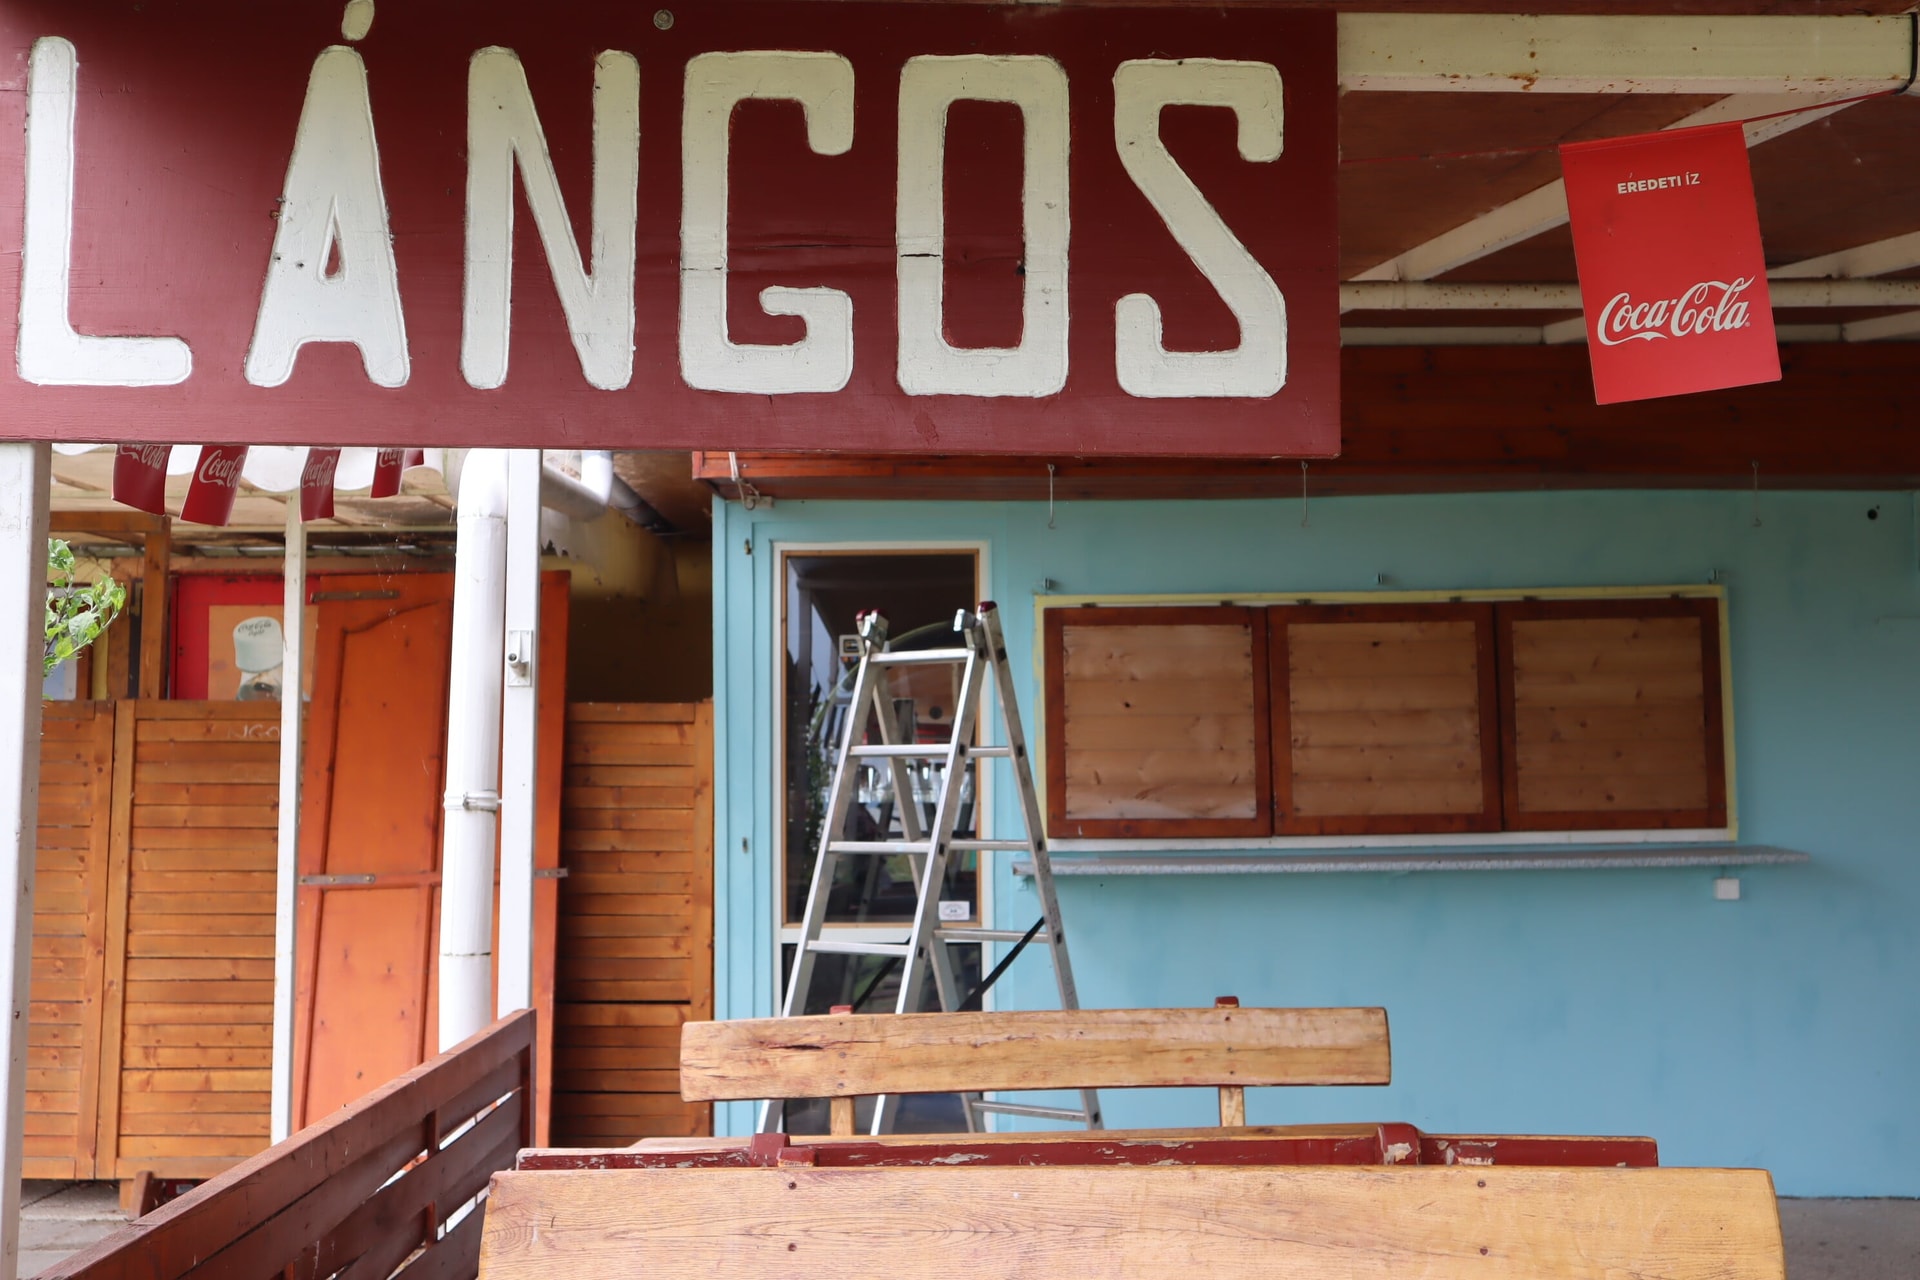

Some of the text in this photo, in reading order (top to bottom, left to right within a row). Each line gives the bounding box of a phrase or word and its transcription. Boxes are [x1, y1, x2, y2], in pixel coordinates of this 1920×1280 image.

[17, 0, 1288, 398] LÁNGOS
[1617, 171, 1701, 195] EREDETI ÍZ
[1597, 275, 1756, 346] Coca-Cola
